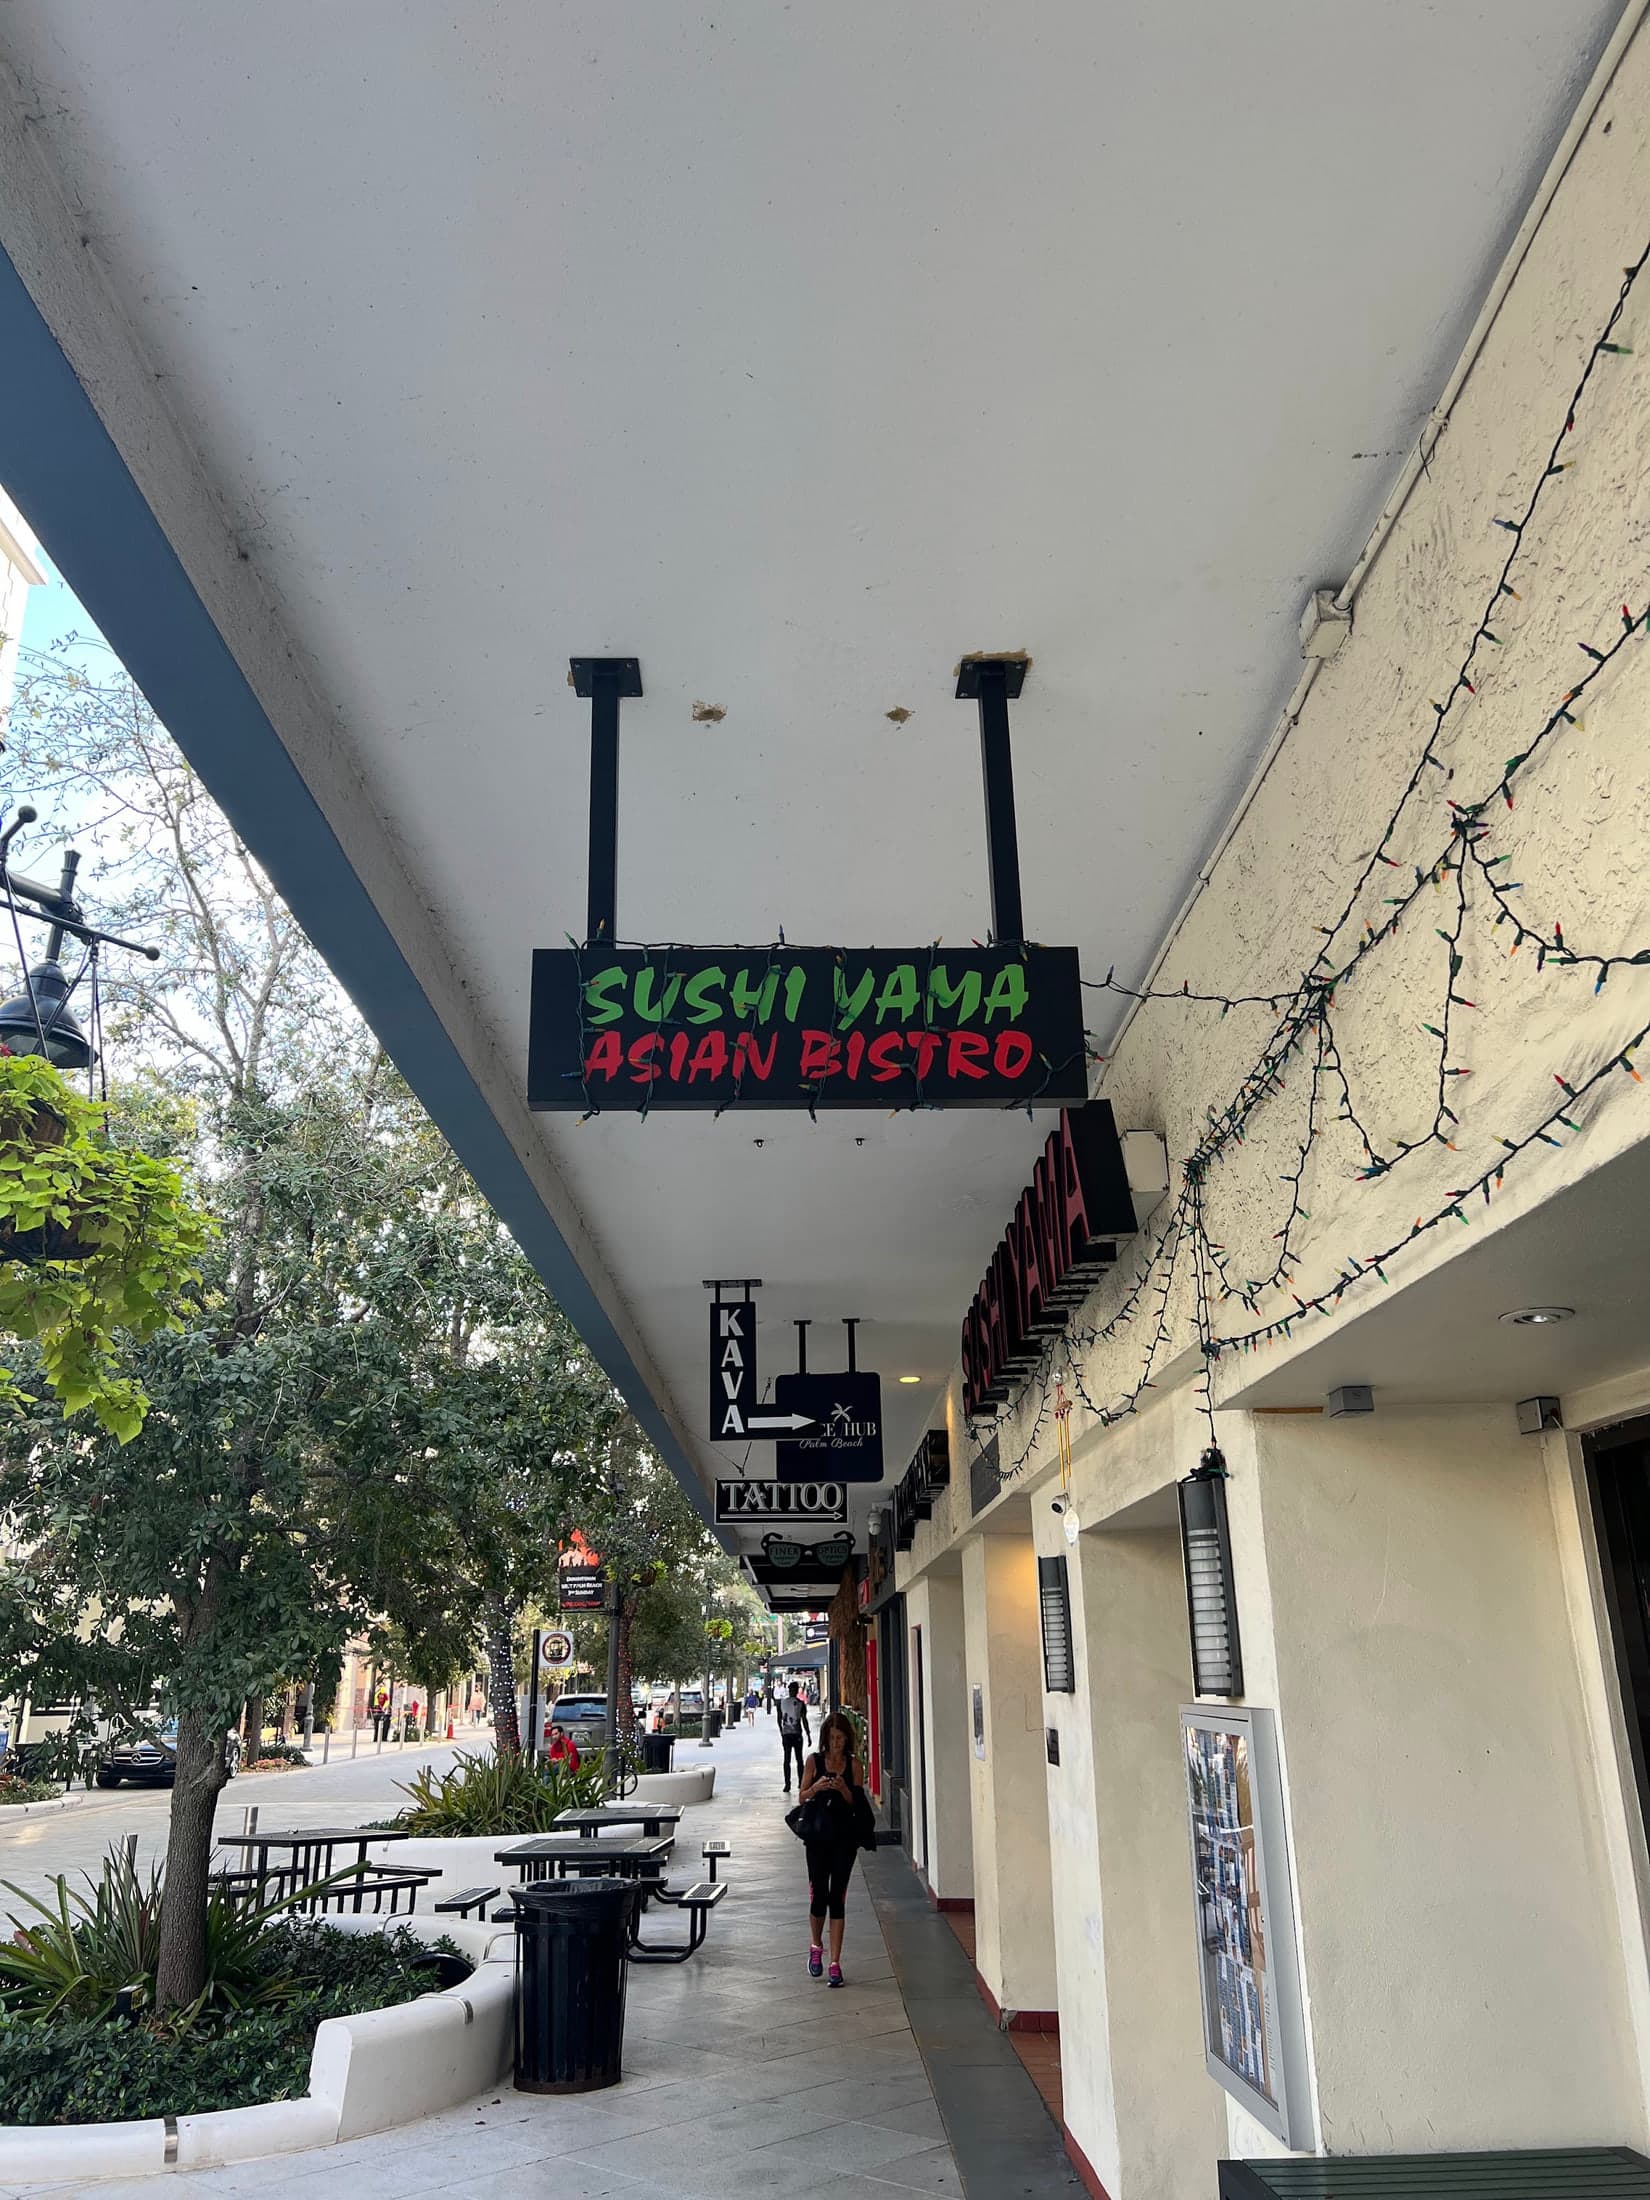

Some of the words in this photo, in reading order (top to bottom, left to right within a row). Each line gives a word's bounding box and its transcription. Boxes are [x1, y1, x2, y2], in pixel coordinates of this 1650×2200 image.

[585, 964, 807, 1024] SUSHI
[833, 962, 1030, 1031] YAMA
[584, 1030, 778, 1083] ASIAN
[800, 1029, 1034, 1082] BISTRO
[719, 1308, 745, 1434] KAVA
[799, 1438, 828, 1449] Palm
[831, 1436, 864, 1449] Beach
[844, 1421, 877, 1437] HUB
[720, 1481, 845, 1513] TATTOO
